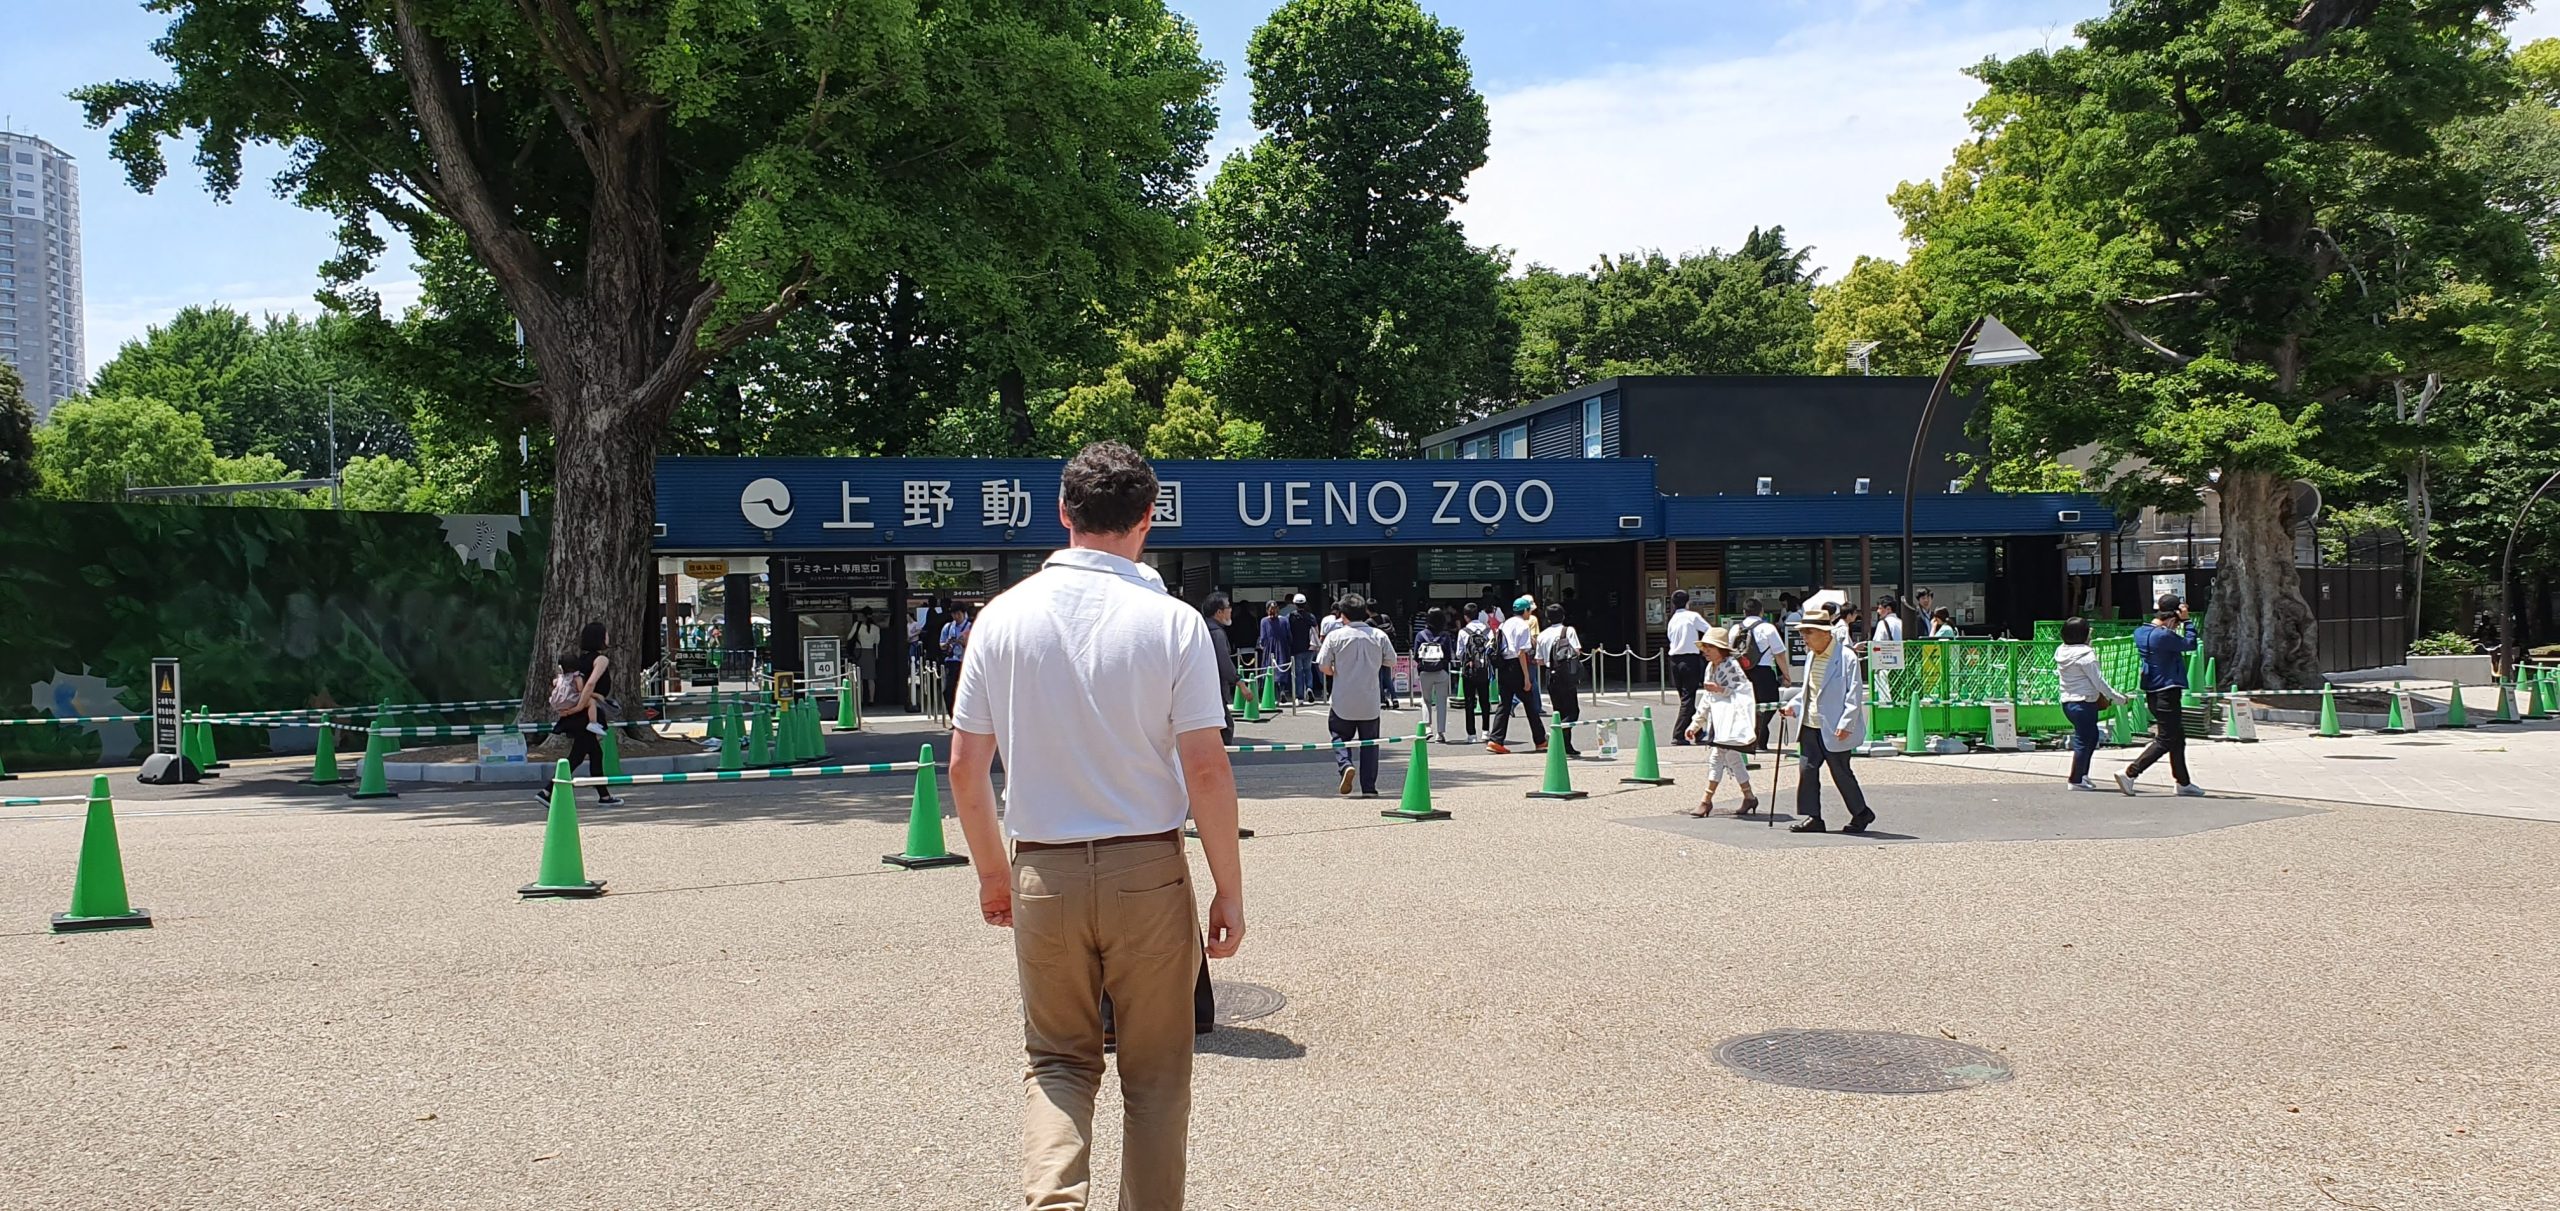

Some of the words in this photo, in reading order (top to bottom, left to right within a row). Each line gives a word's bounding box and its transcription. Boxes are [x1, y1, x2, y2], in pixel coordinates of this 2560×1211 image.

[822, 479, 1182, 528] 上野動園
[1237, 480, 1407, 527] UENO
[1432, 479, 1555, 524] ZOO
[793, 564, 880, 574] ラミネート専用窓口
[818, 664, 831, 672] 40
